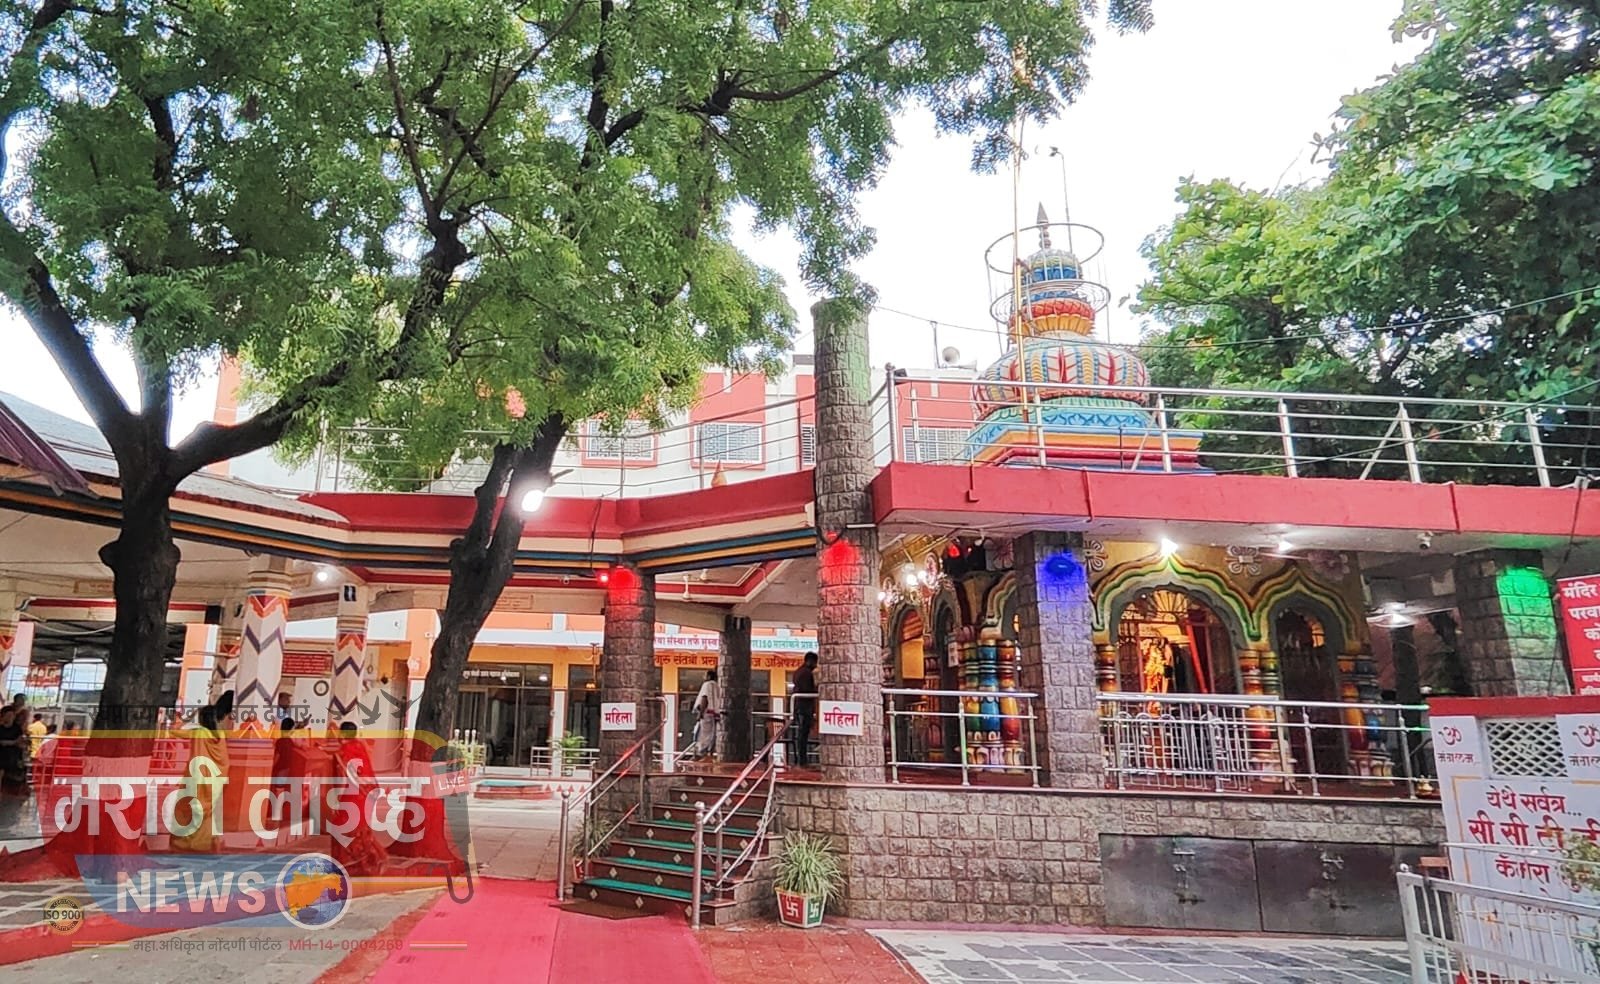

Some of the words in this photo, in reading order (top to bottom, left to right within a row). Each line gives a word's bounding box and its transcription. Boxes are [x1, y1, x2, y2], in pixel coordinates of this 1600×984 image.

[604, 707, 632, 725] महिला
[823, 706, 859, 728] महिला
[1486, 784, 1517, 810] येथे
